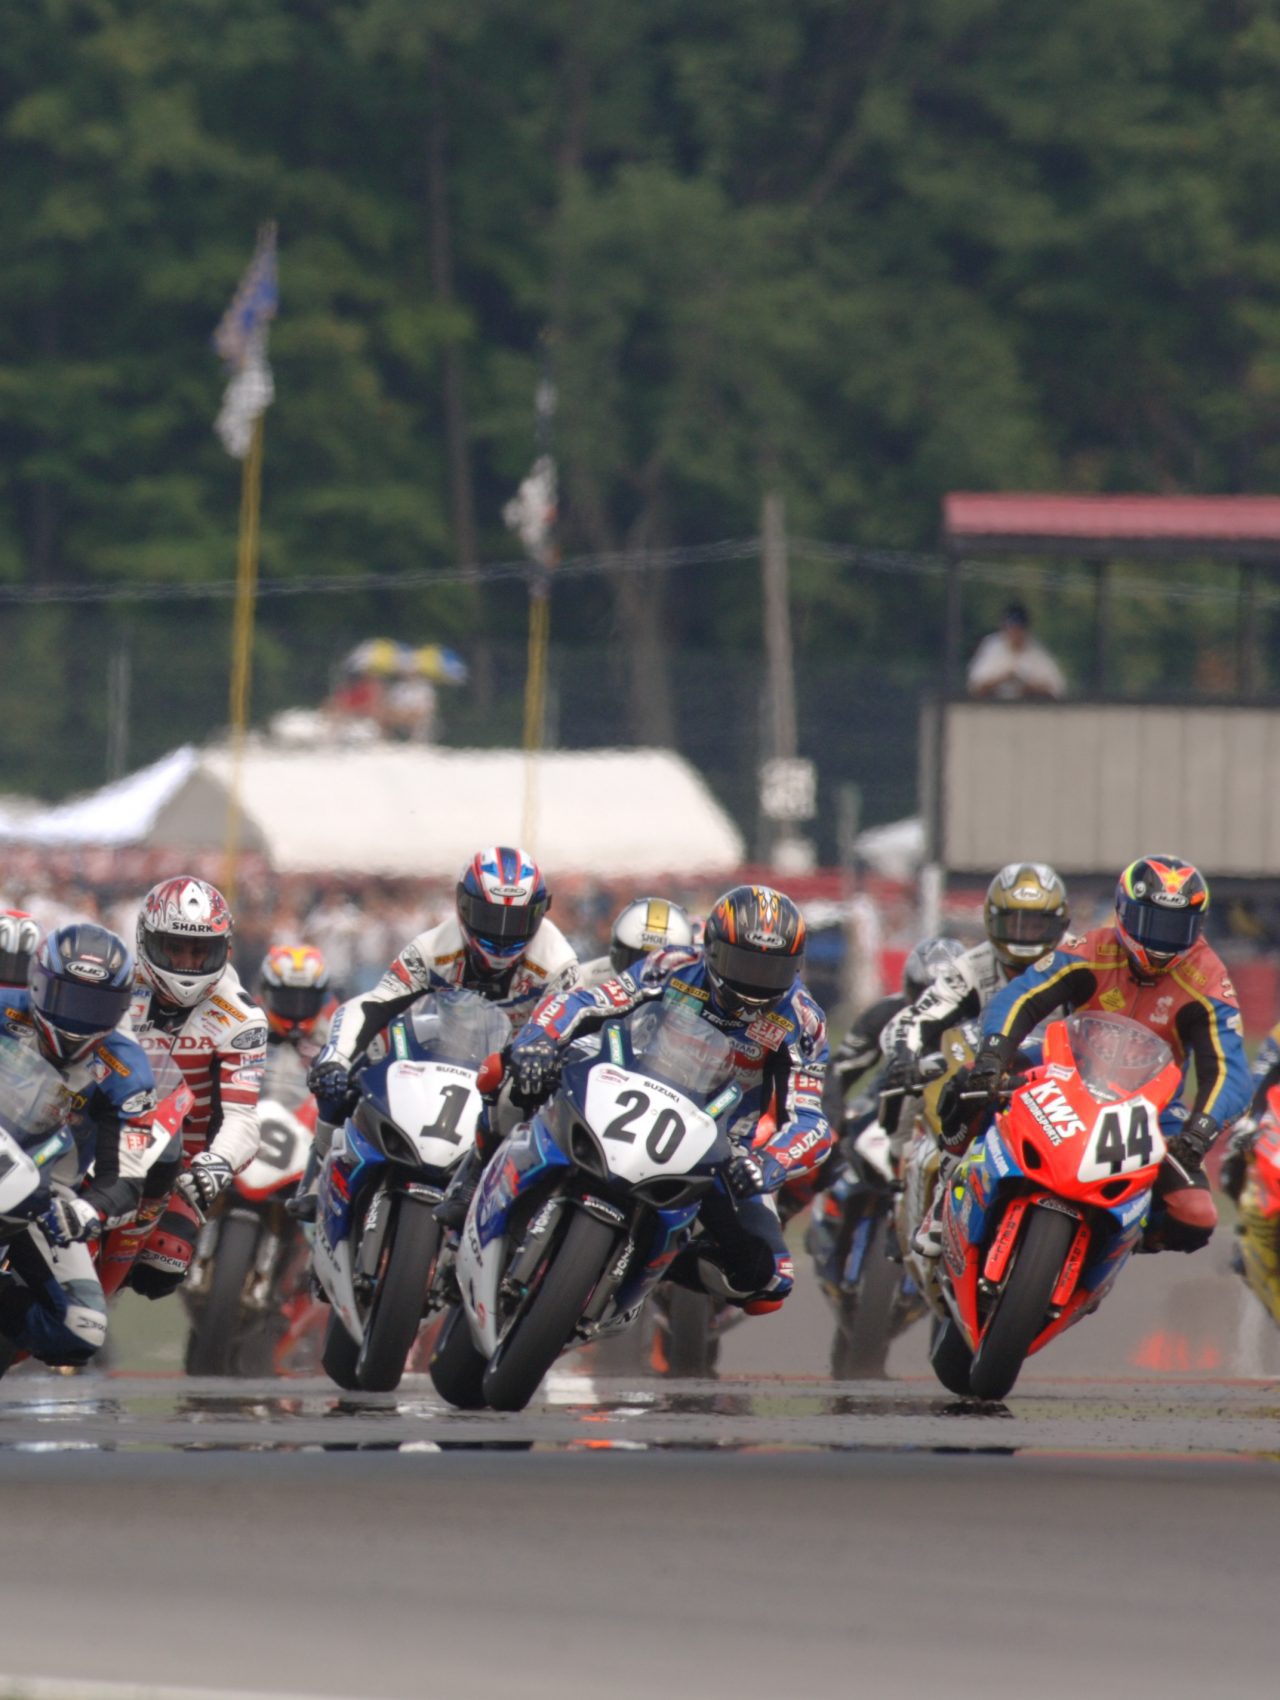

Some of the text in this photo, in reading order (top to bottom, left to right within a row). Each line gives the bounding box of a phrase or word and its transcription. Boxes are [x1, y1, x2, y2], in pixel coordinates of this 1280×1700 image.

[172, 922, 213, 933] SHARK
[752, 933, 781, 945] HJC
[73, 965, 104, 977] HJC
[537, 992, 570, 1027] SUZUK
[702, 1009, 744, 1027] TEKNIC
[139, 1036, 218, 1050] ONDA
[435, 1065, 473, 1079] SUZUKI
[643, 1080, 680, 1103] SUZUKI
[419, 1083, 472, 1145] 1
[1019, 1092, 1063, 1147] MOTORSPORTS
[1030, 1079, 1087, 1138] KWS
[602, 1089, 687, 1165] 20
[788, 1117, 830, 1160] SUZUKI
[1095, 1105, 1153, 1175] 44
[583, 1200, 622, 1222] SUZUKI
